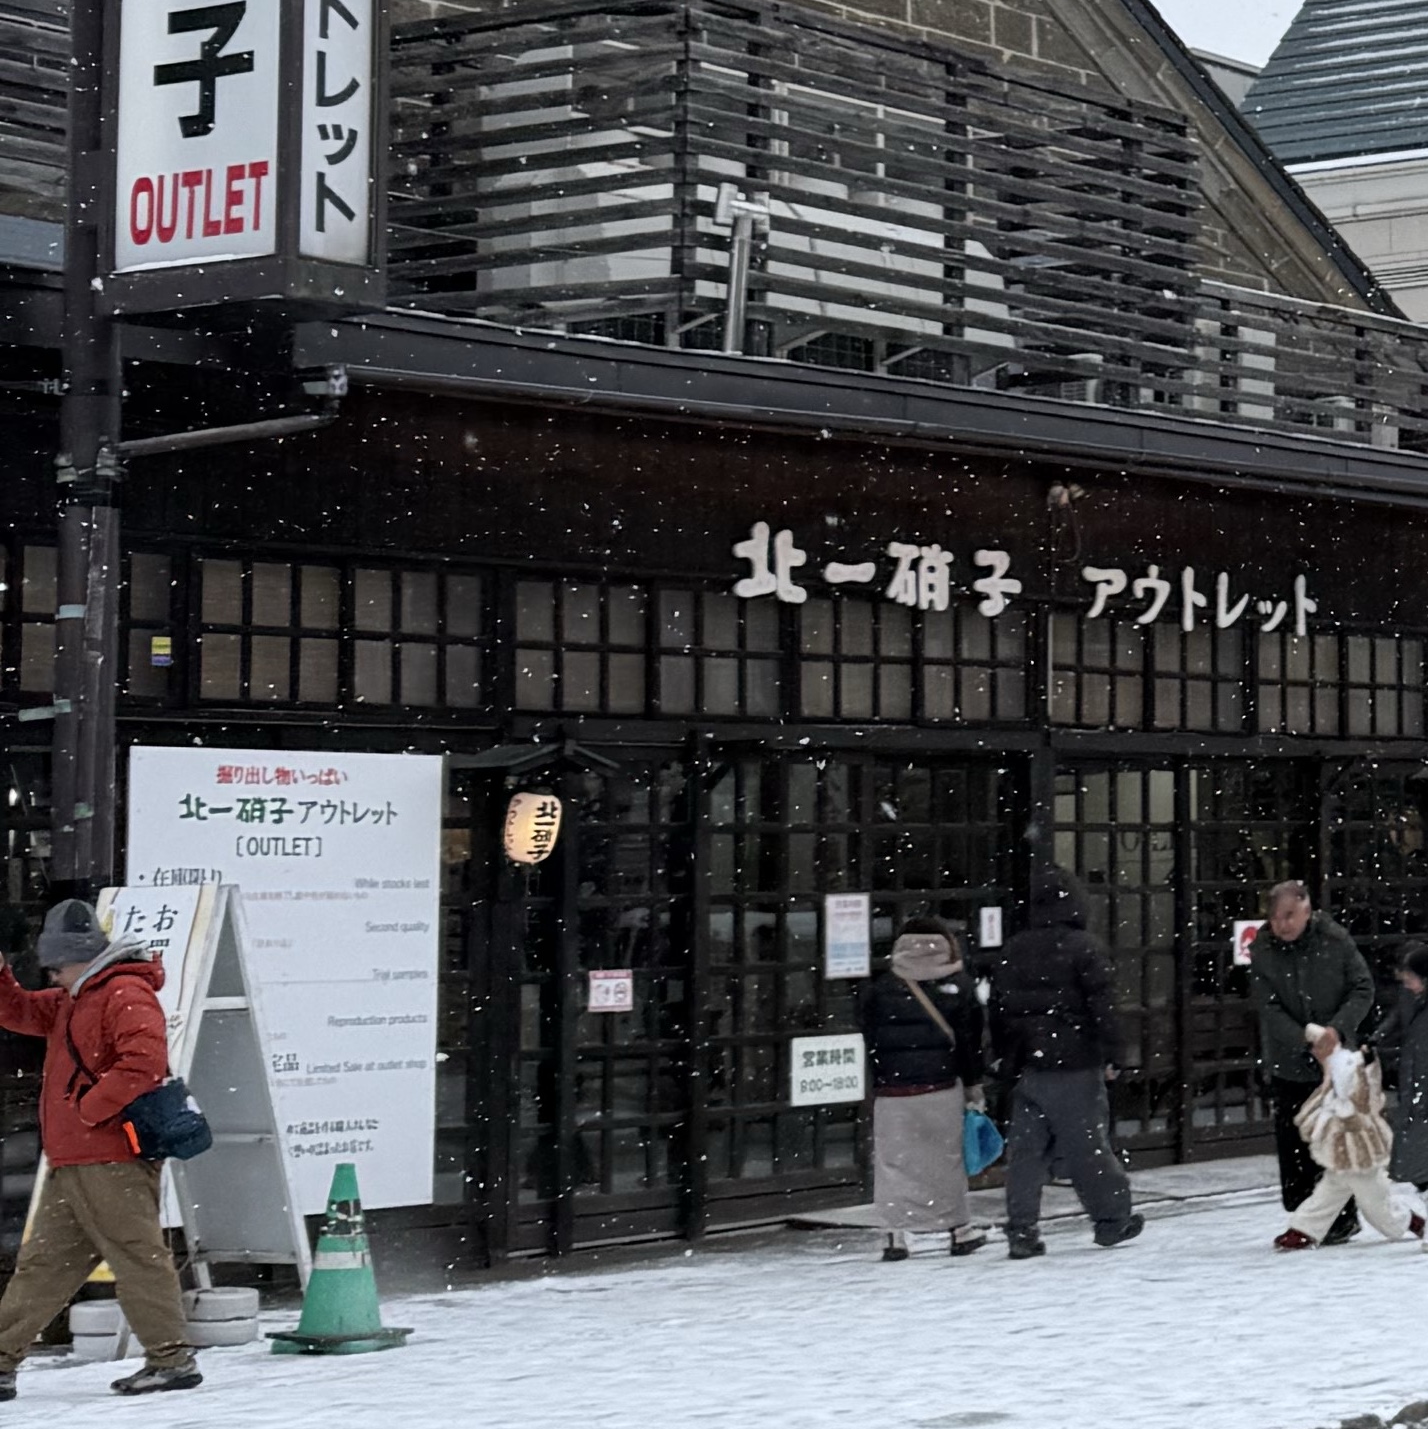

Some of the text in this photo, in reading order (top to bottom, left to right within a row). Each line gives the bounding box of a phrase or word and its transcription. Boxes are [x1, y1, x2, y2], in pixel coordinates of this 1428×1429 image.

[129, 160, 269, 246] OUTLET
[732, 521, 1317, 636] 北一硝子 アウトレット
[178, 793, 398, 825] 北一硝子 アウトレット
[365, 921, 398, 933] Second
